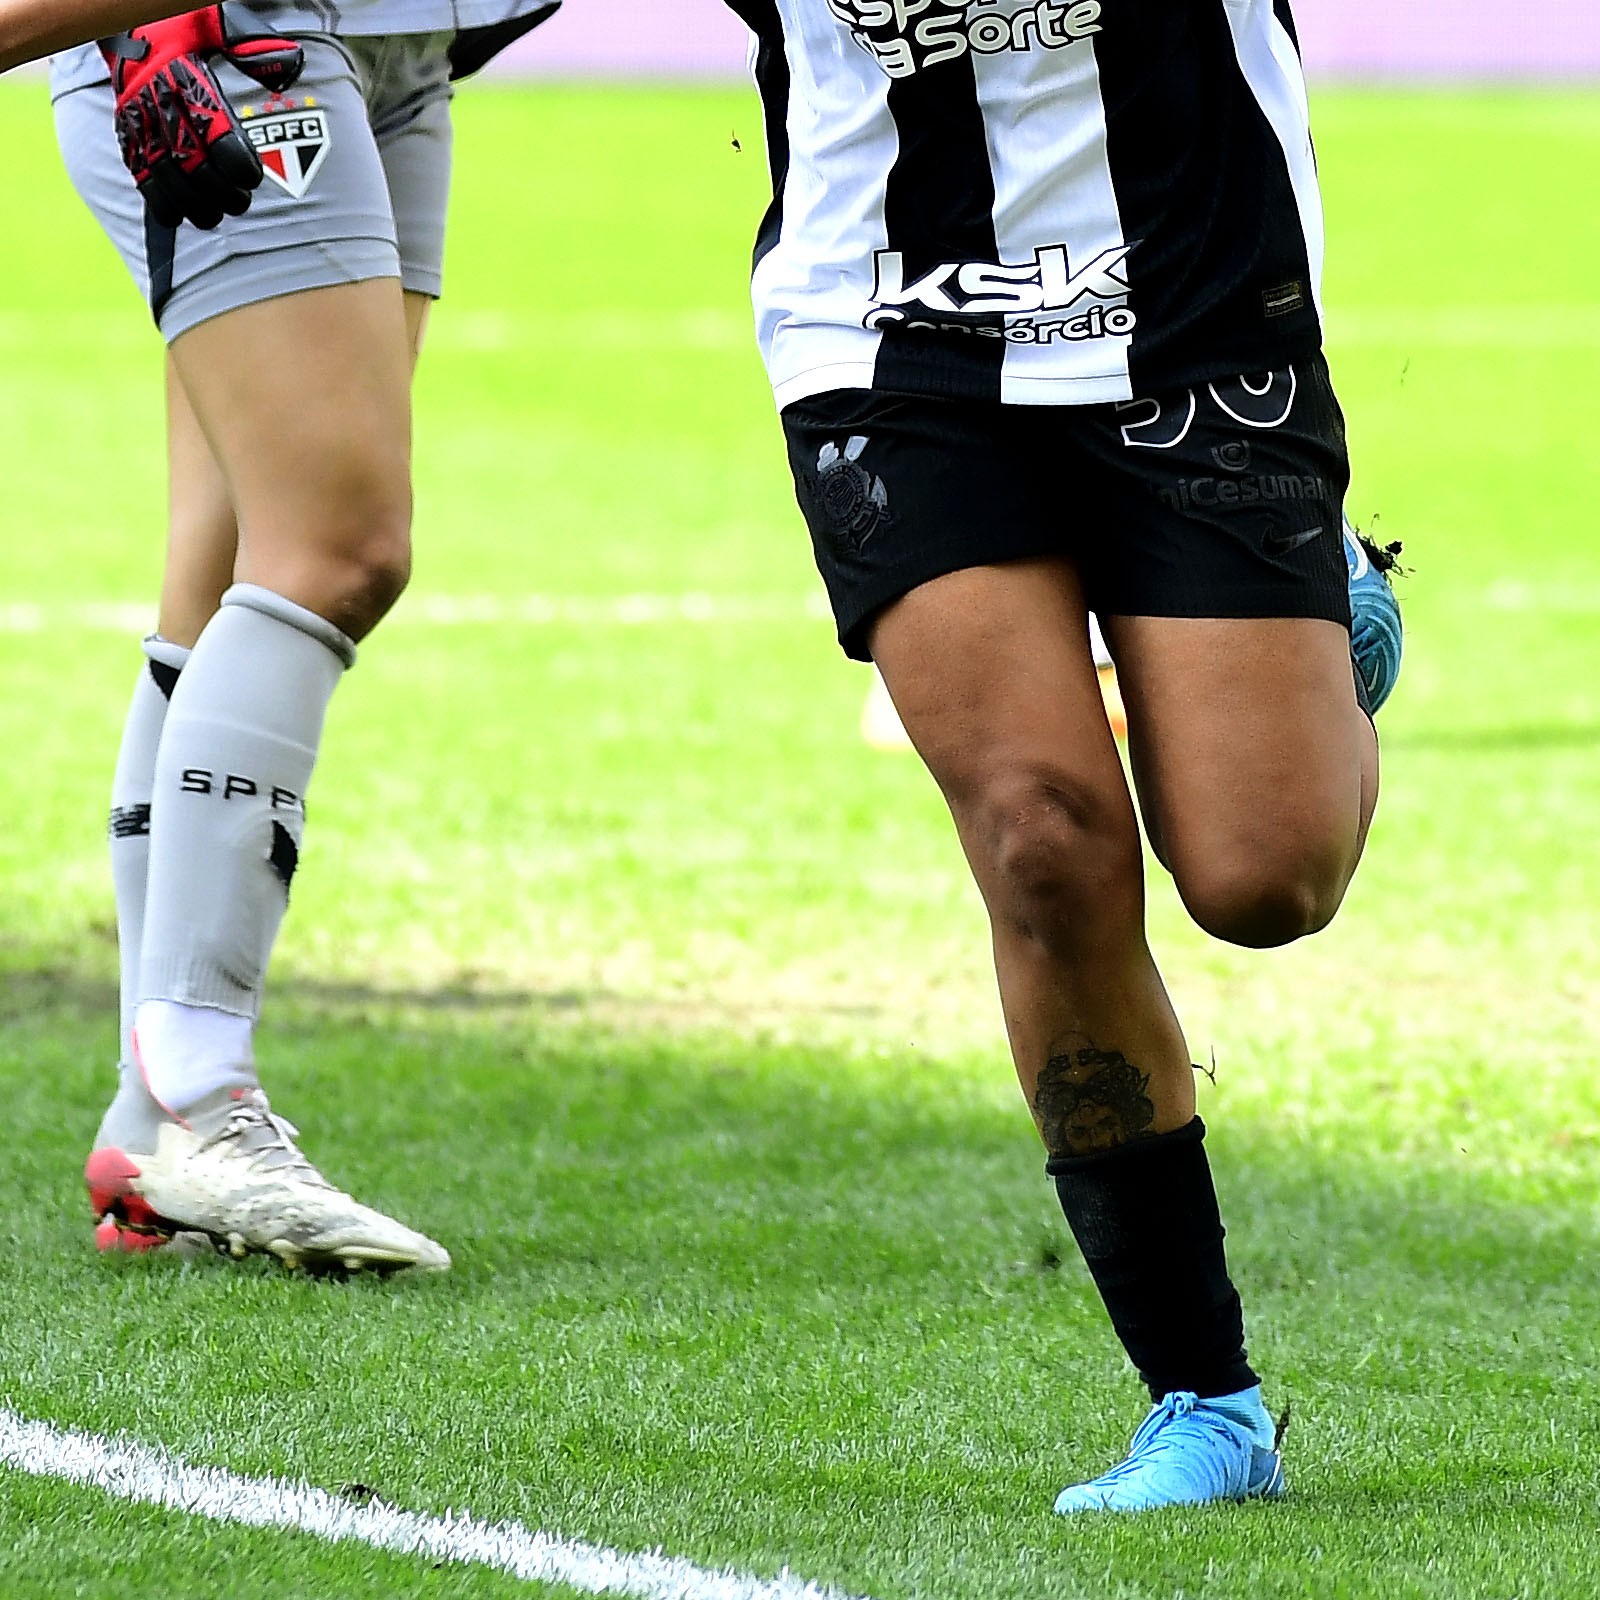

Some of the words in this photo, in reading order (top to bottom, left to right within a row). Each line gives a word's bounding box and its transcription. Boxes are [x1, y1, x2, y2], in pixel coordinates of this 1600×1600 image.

[914, 0, 1104, 68] Sorte
[247, 120, 321, 146] SPFC
[179, 767, 306, 821] SPF
